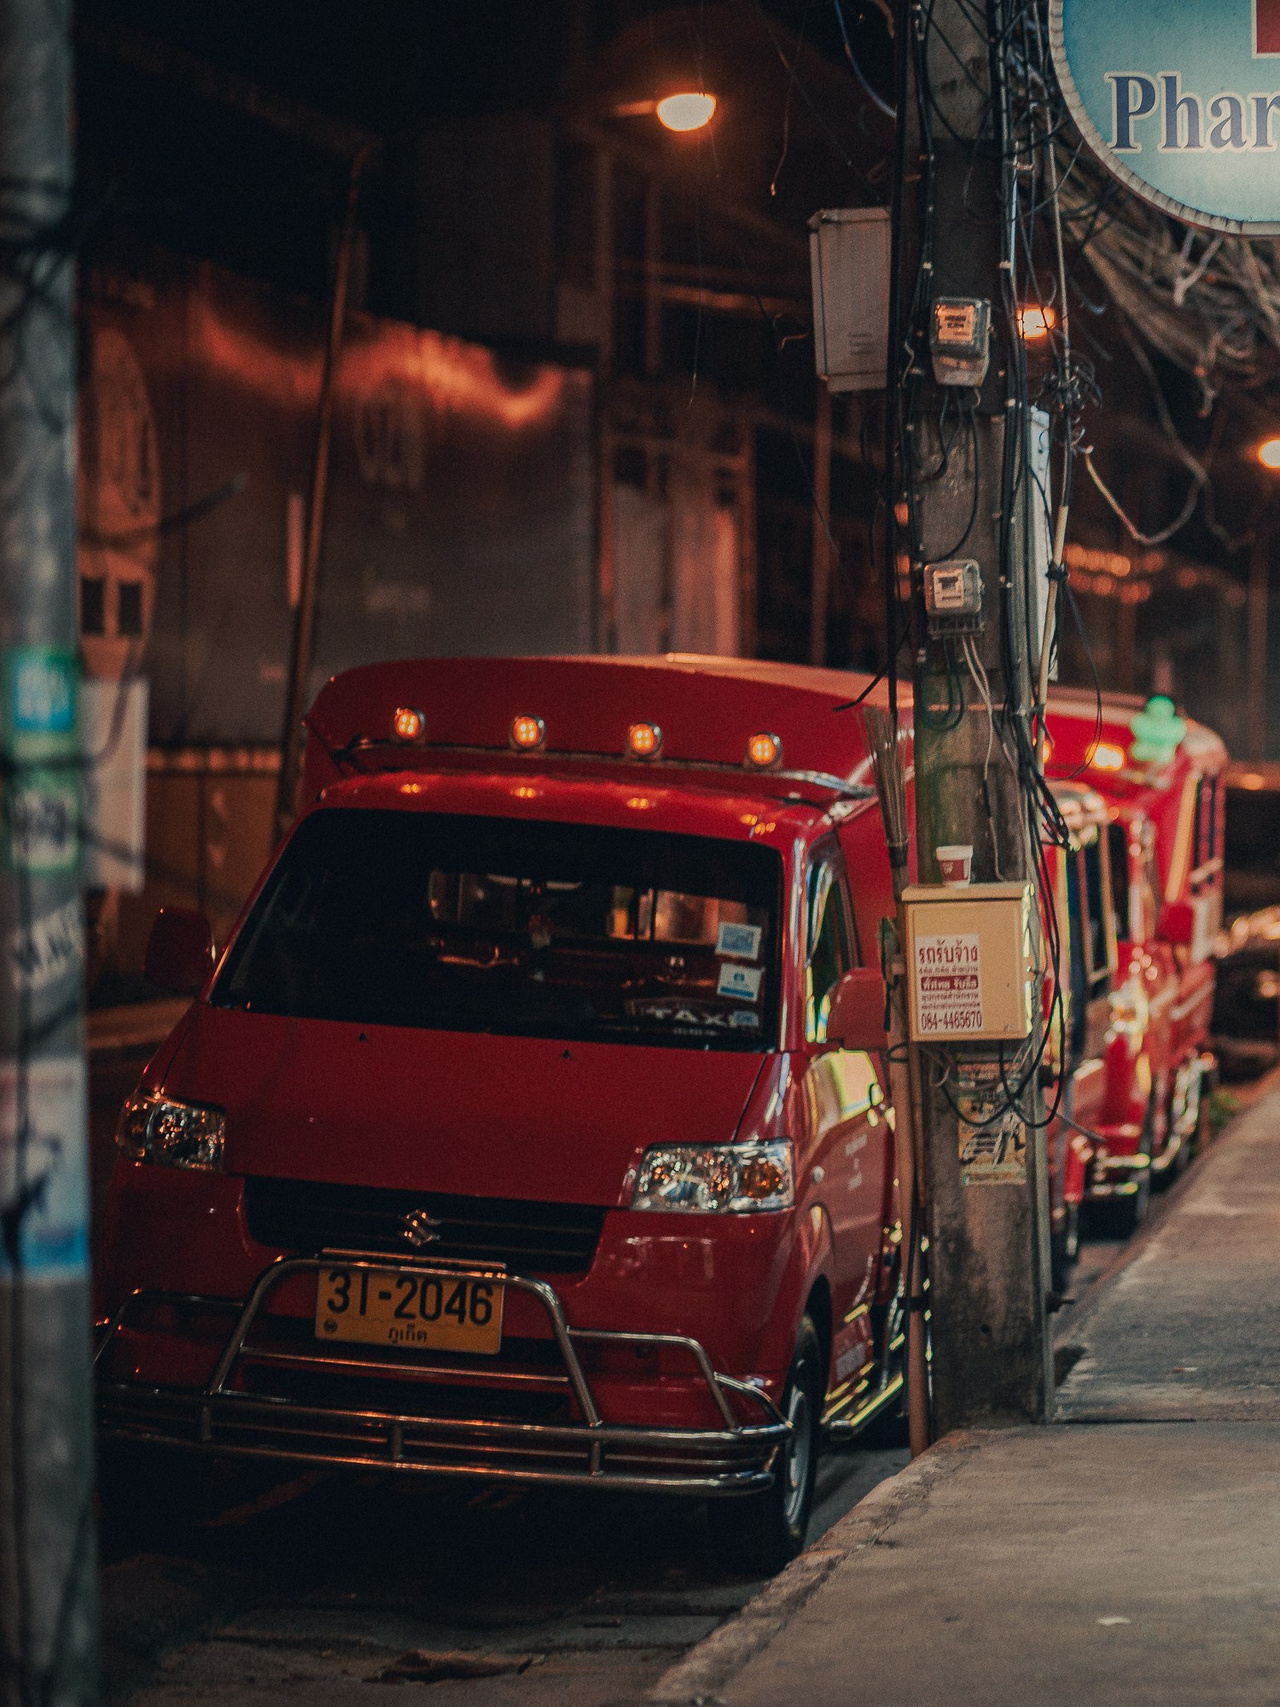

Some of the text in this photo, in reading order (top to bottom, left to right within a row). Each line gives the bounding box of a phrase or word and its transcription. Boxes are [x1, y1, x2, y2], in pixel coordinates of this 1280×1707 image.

[919, 939, 978, 964] รถรับจ้าง
[327, 1270, 493, 1325] 31-2046
